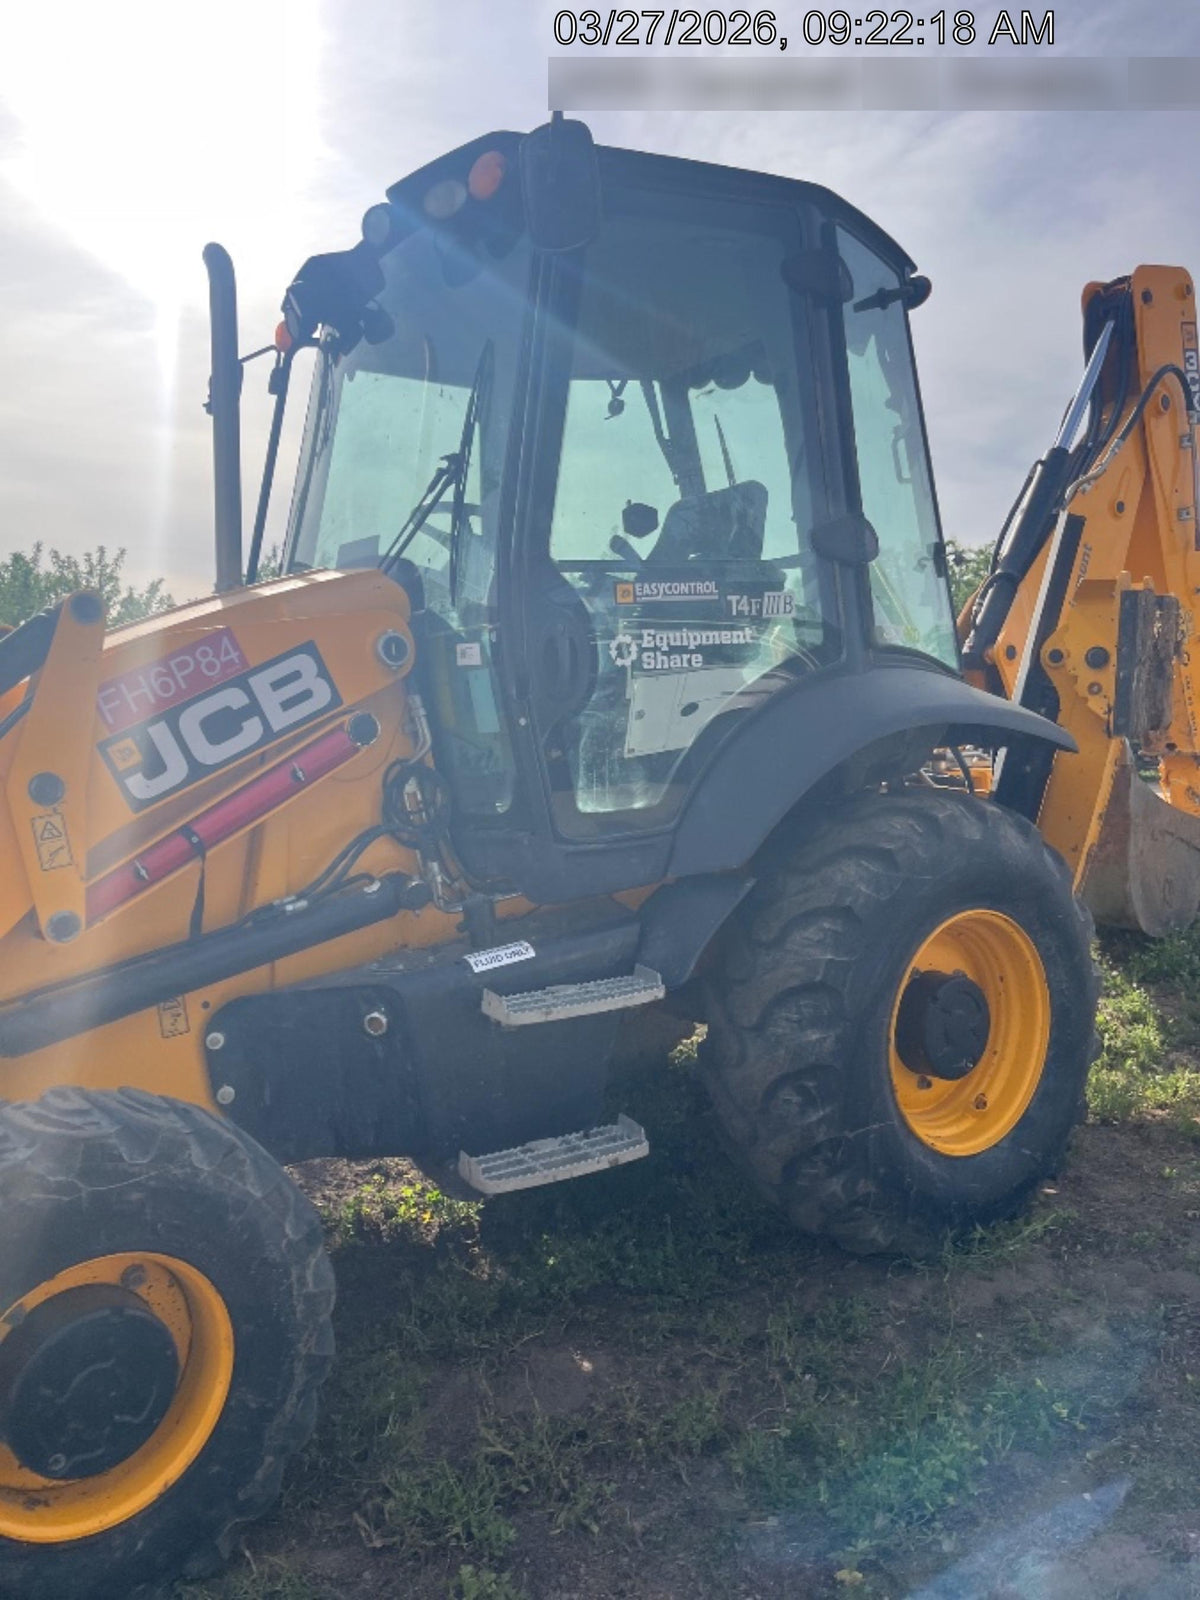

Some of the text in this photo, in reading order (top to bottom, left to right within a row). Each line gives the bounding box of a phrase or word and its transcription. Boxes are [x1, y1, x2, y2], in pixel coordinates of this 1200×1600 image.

[640, 627, 753, 651] Equipment
[640, 652, 704, 670] Share
[98, 635, 241, 726] FH6P84
[123, 653, 332, 800] JCB
